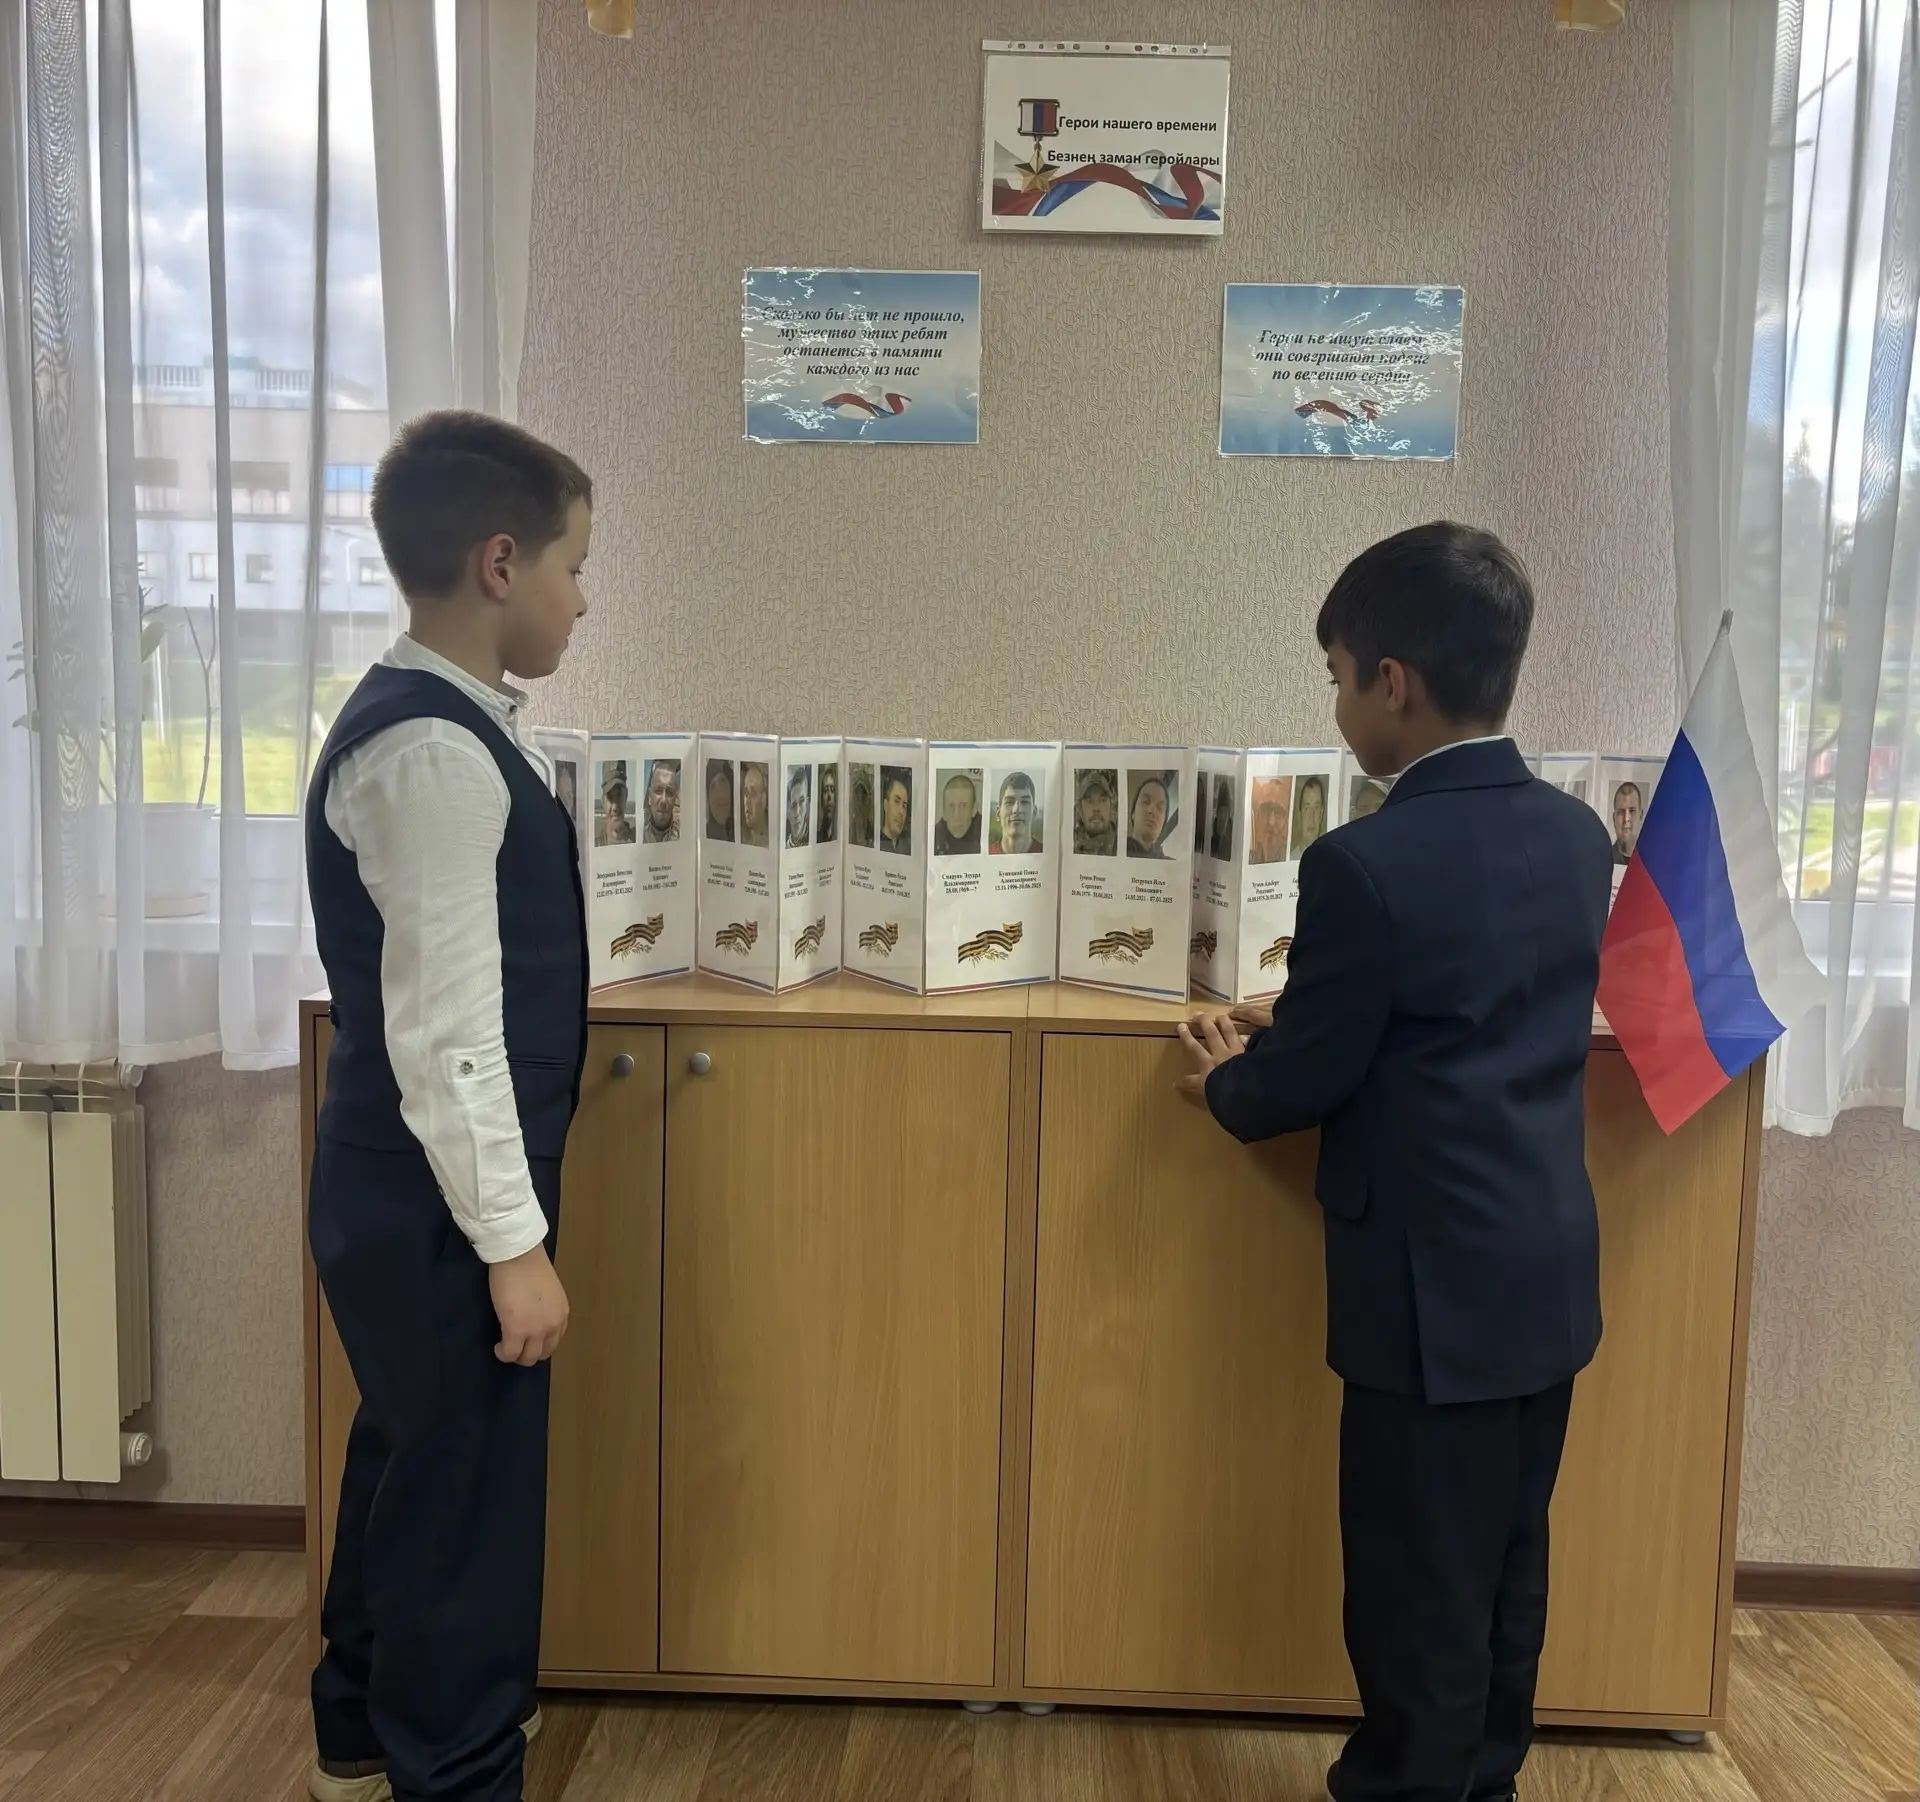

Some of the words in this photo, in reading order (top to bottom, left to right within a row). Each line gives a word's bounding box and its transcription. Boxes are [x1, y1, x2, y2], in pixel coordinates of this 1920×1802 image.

[1058, 116, 1099, 131] Герои
[1102, 120, 1152, 130] нашего
[1156, 121, 1217, 133] времени
[1047, 150, 1096, 164] Безнең
[1100, 154, 1141, 164] заман
[1145, 153, 1220, 168] геройлары
[762, 306, 820, 322] Сколько
[825, 307, 844, 322] бы
[882, 311, 899, 322] не
[903, 311, 965, 325] прошло,
[777, 327, 857, 342] мужество
[861, 329, 899, 341] этих
[901, 326, 948, 343] ребят
[1258, 330, 1304, 347] Герои
[1307, 334, 1325, 345] не
[783, 346, 866, 358] останется
[881, 347, 943, 359] памяти
[1255, 351, 1283, 362] они
[1287, 351, 1375, 366] совершают
[806, 362, 870, 376] каждого
[874, 365, 890, 376] из
[894, 365, 920, 376] нас
[1272, 370, 1291, 381] по
